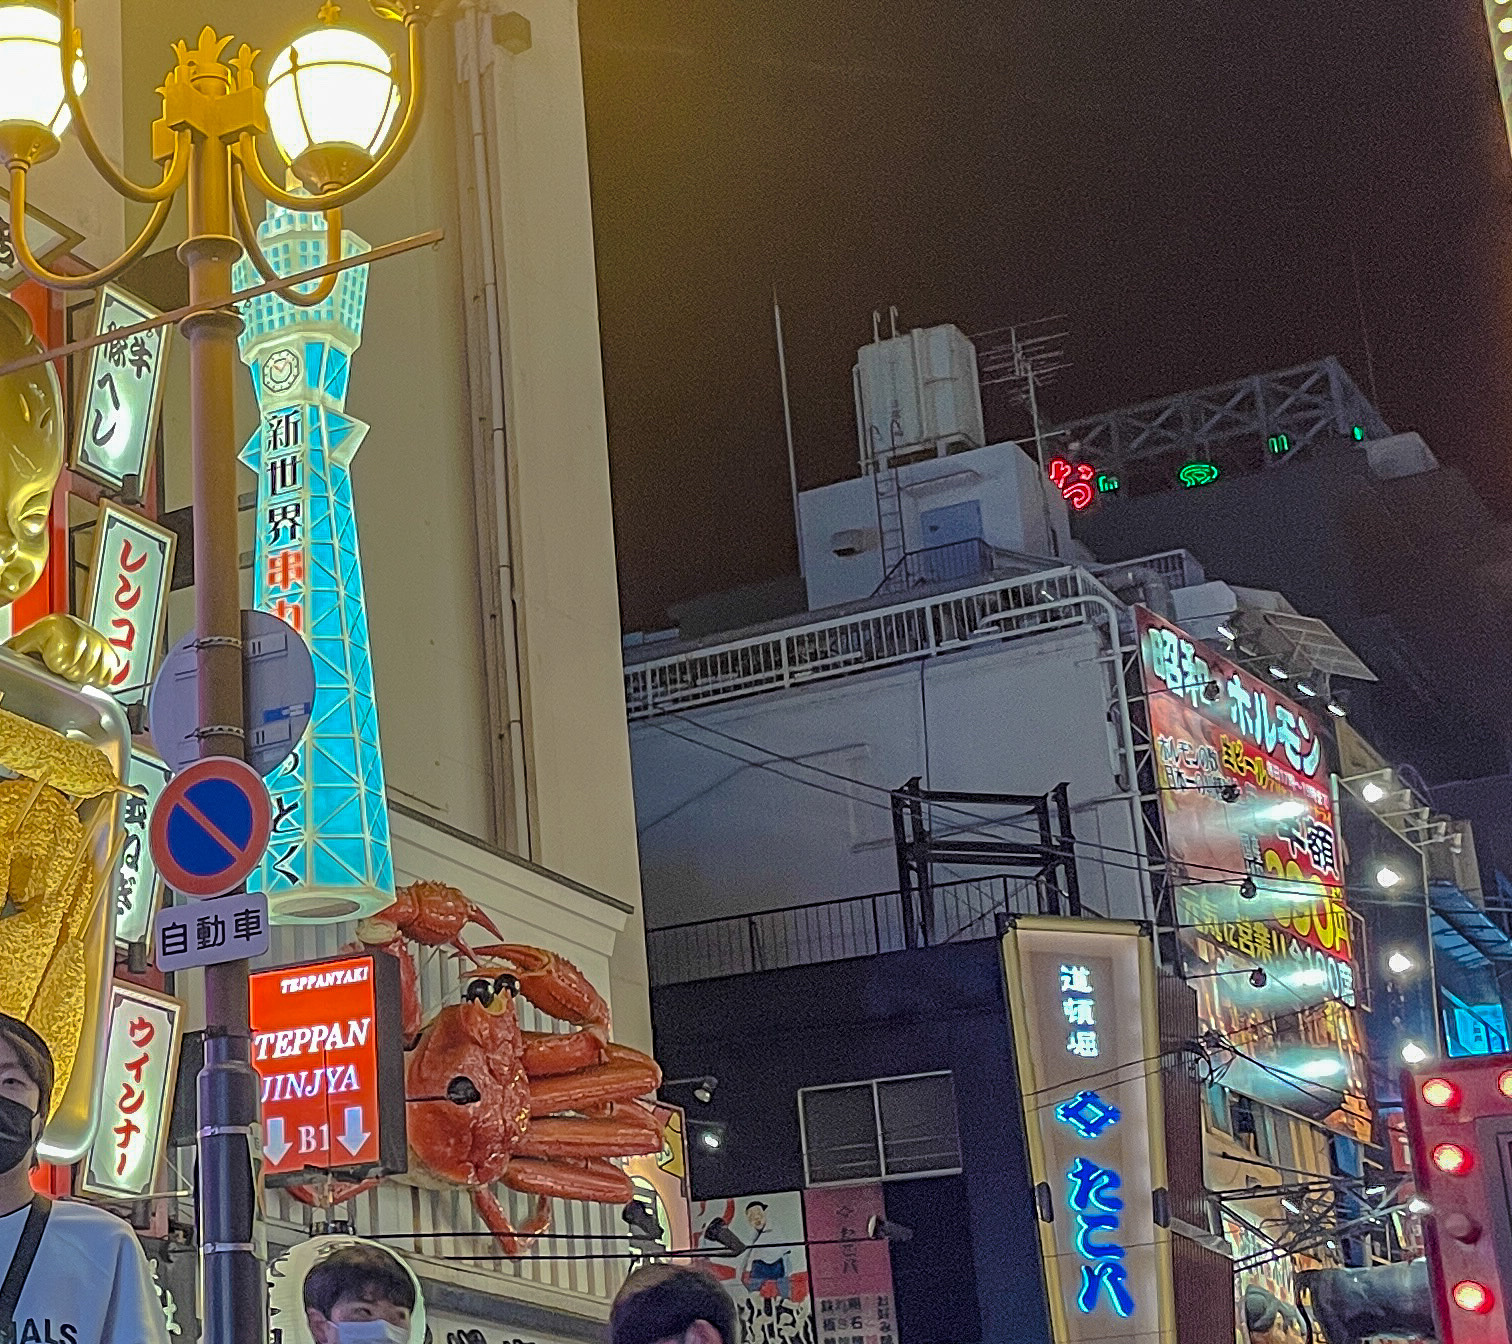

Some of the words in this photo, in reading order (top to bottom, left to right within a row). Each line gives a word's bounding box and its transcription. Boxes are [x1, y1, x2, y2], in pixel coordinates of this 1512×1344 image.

[1225, 673, 1322, 777] ホルモン
[161, 907, 263, 957] 自動車
[280, 966, 369, 994] TEPPANYAKI
[1059, 964, 1100, 1059] 道頓堀
[253, 1017, 371, 1061] TEPPAN
[112, 1015, 156, 1176] ウインナー
[261, 1064, 360, 1103] JINJYA
[297, 1123, 331, 1155] B1
[1067, 1156, 1134, 1319] たこ八
